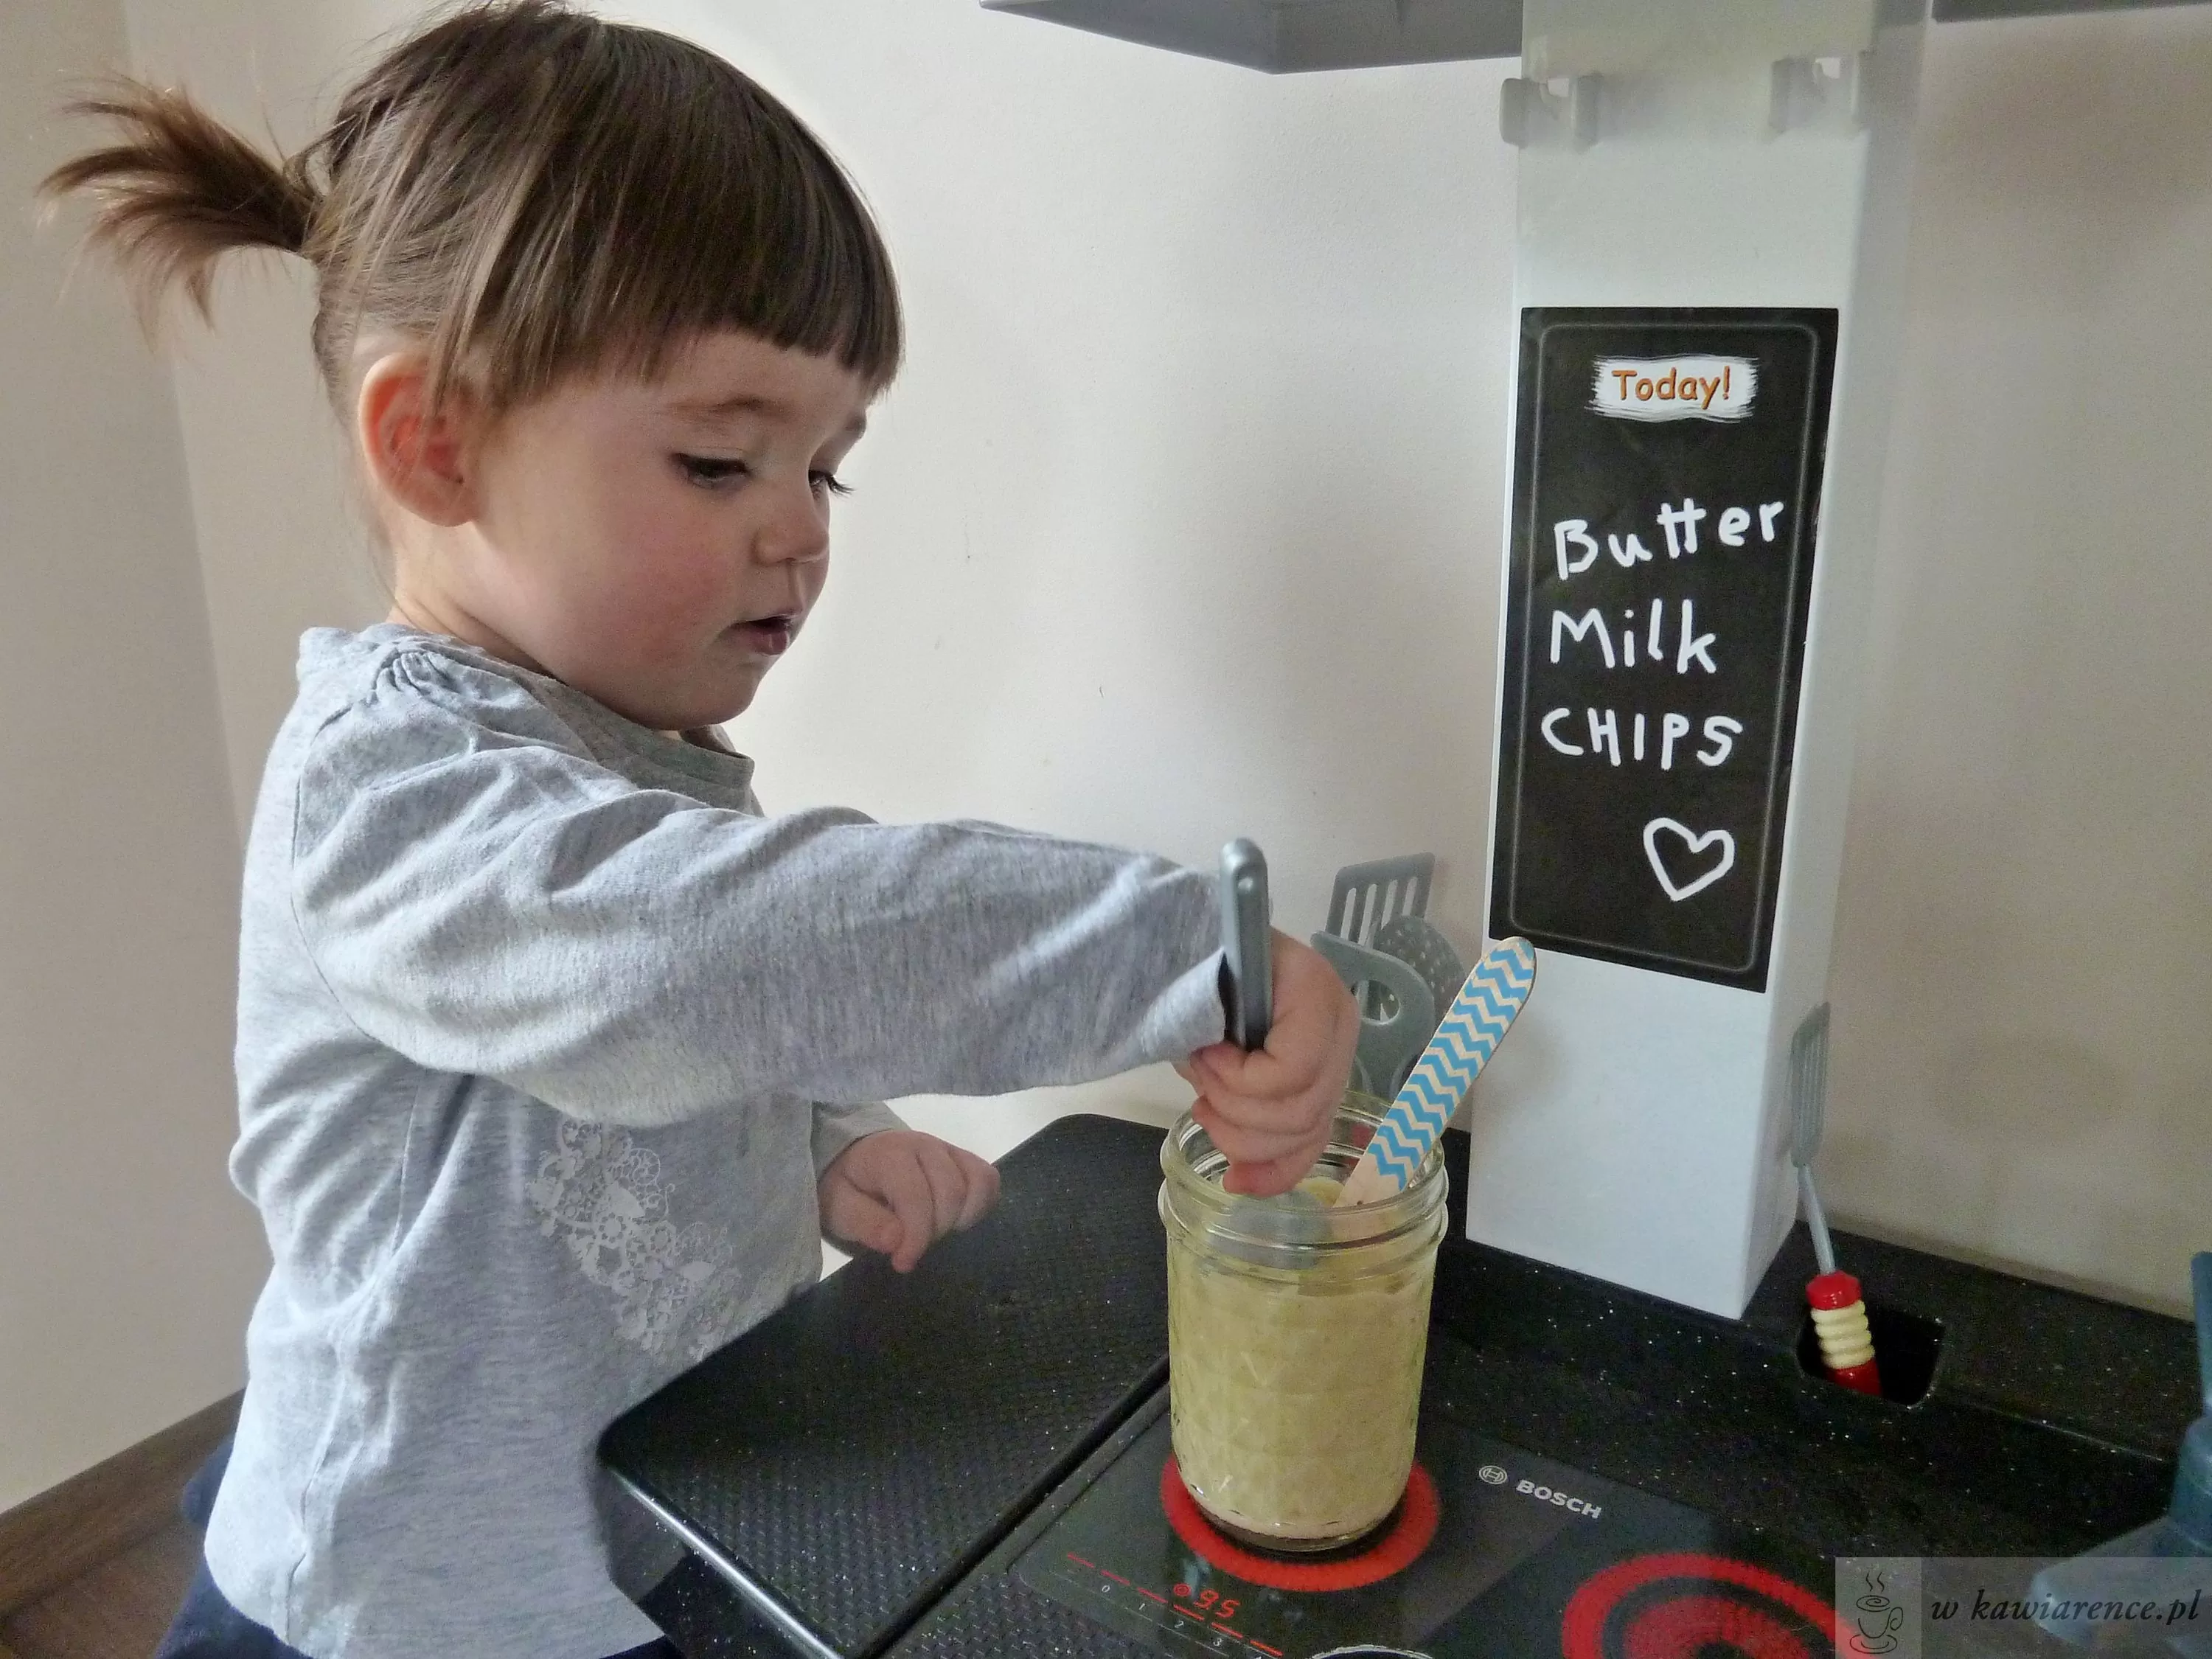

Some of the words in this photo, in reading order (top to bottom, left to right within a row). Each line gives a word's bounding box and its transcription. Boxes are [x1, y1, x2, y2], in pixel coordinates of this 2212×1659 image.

[1612, 365, 1730, 408] Today!
[1554, 498, 1784, 580] Butter
[1550, 598, 1717, 674] Milk
[1541, 707, 1743, 771] CHIPS
[1516, 1479, 1602, 1520] BOSCH
[1213, 1638, 1222, 1647] 3
